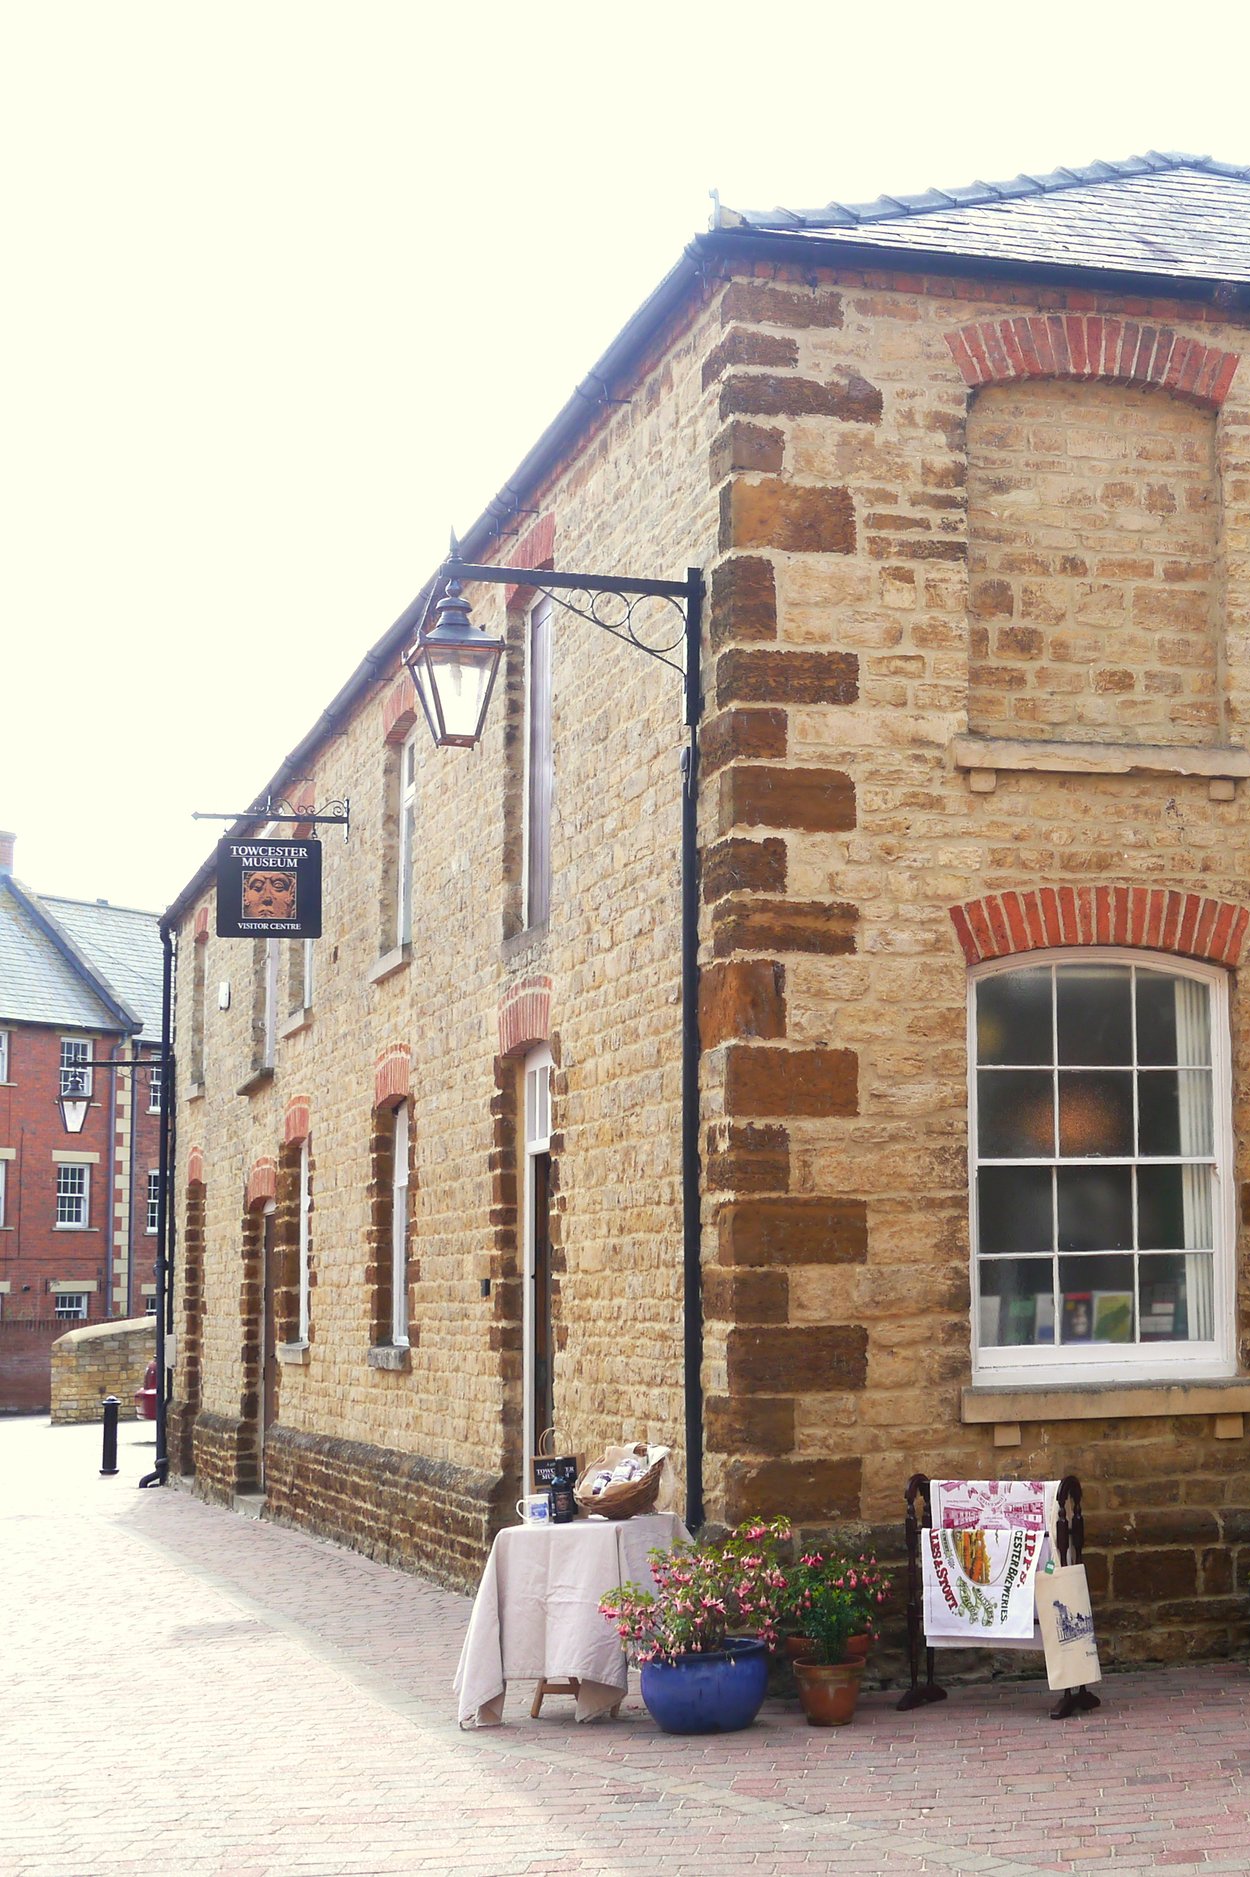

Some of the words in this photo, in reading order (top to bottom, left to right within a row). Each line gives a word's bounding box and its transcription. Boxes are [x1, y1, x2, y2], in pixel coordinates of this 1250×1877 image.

[230, 845, 308, 857] TOWCESTER
[242, 857, 298, 868] MUSEUM
[237, 922, 270, 930] VISITOR
[270, 923, 302, 931] CENTRE
